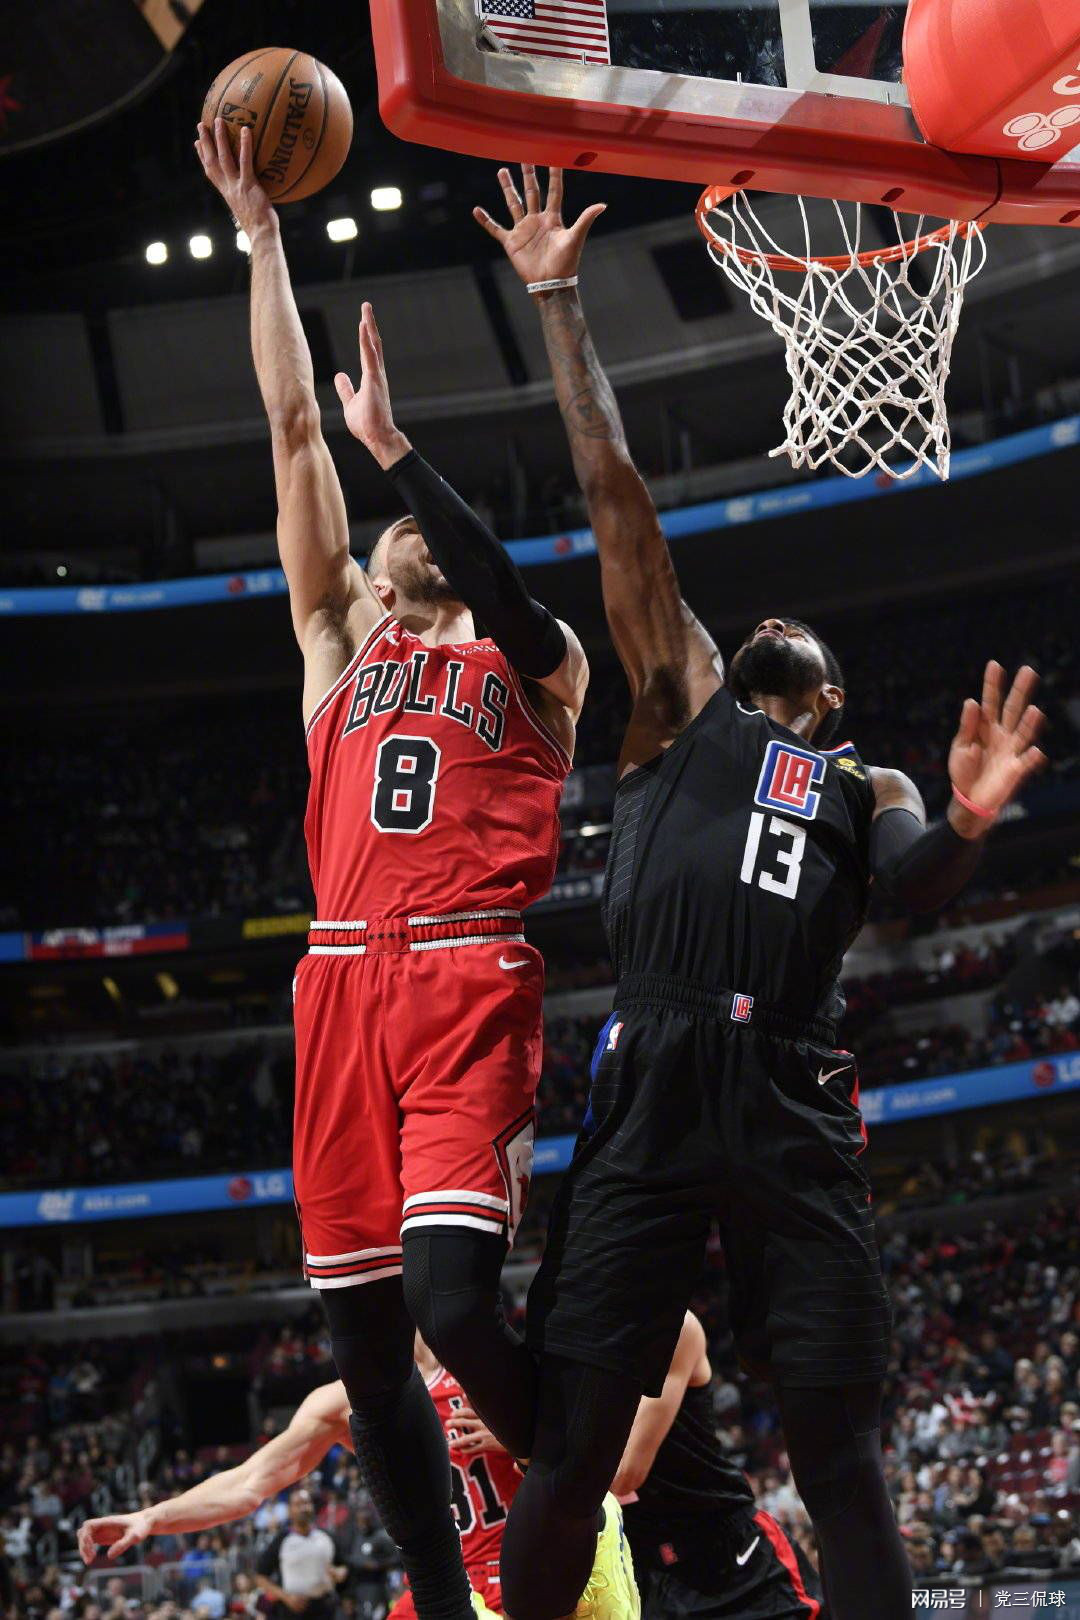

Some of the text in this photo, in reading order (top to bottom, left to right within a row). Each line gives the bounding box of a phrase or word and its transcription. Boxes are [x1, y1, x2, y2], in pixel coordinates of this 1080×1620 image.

[259, 77, 313, 185] SPALDING
[341, 651, 509, 752] BULLS
[370, 733, 442, 835] 8
[740, 811, 807, 900] 13
[254, 1176, 286, 1198] LG
